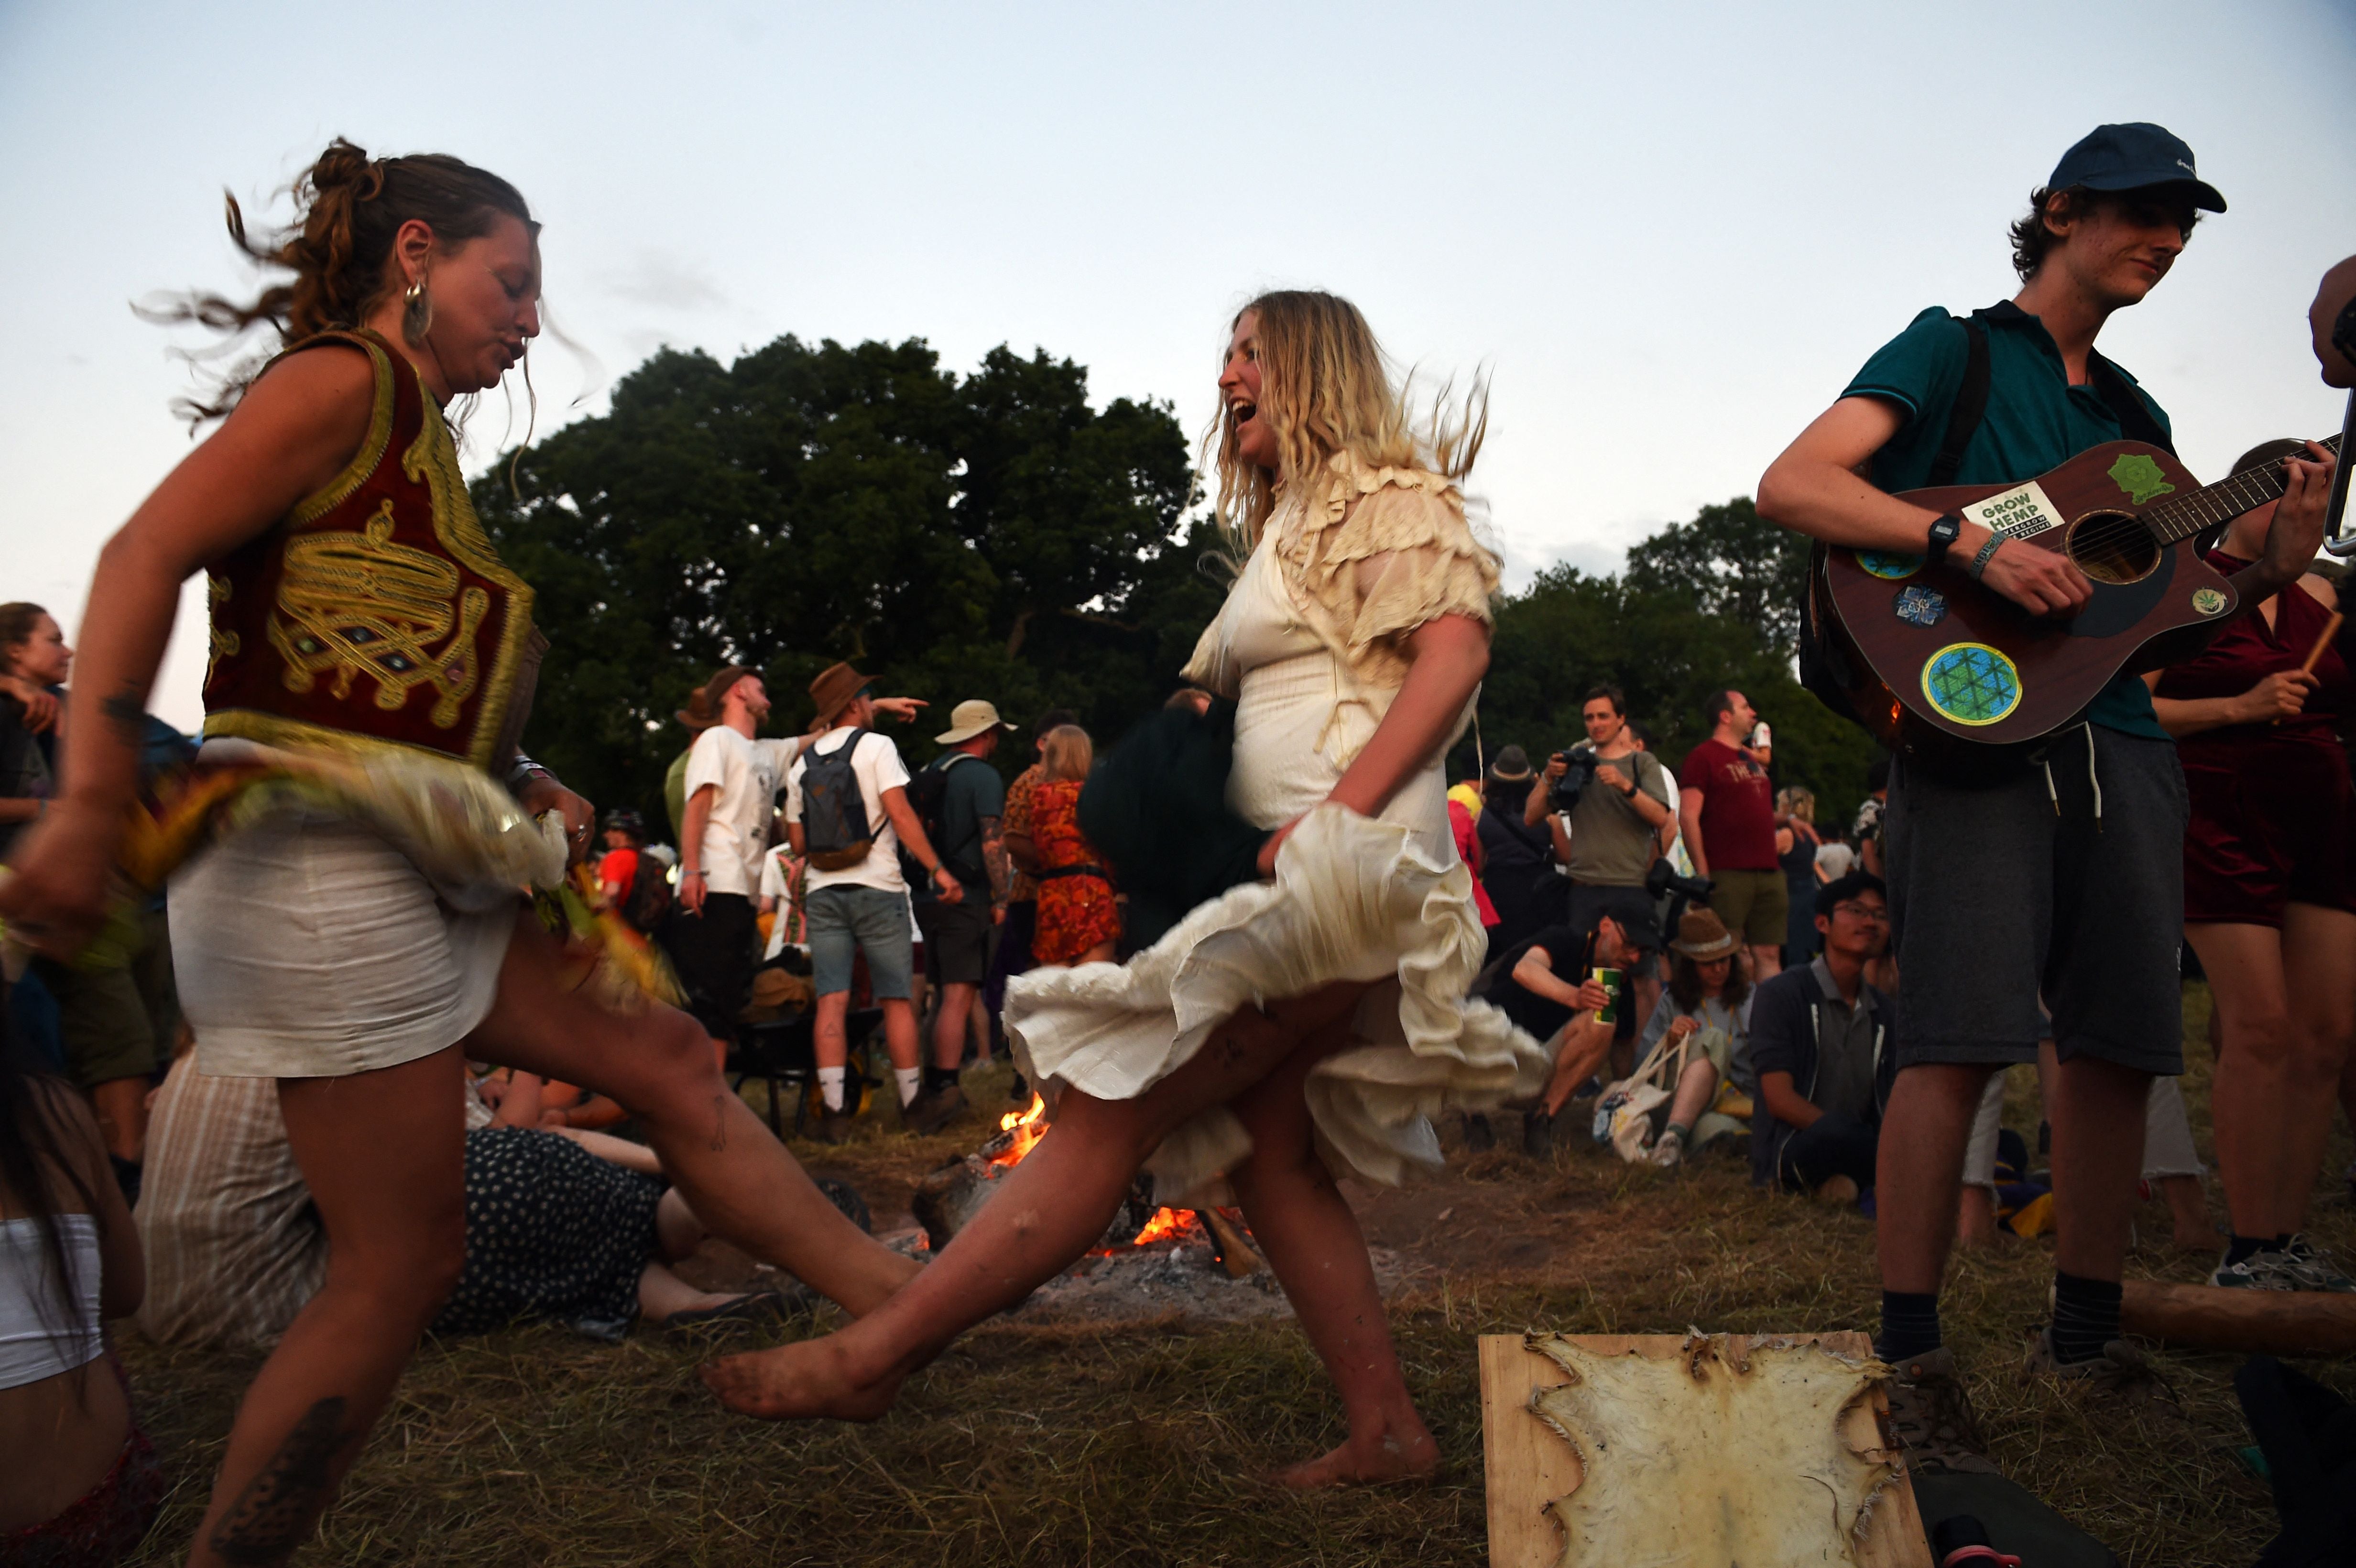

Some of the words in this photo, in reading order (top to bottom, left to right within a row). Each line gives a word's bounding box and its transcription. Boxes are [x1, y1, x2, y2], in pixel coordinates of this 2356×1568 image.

[1982, 493, 2030, 518] GROW
[1989, 505, 2038, 531] HEMP
[2004, 516, 2045, 534] VERGROW
[2021, 523, 2051, 537] REGIME
